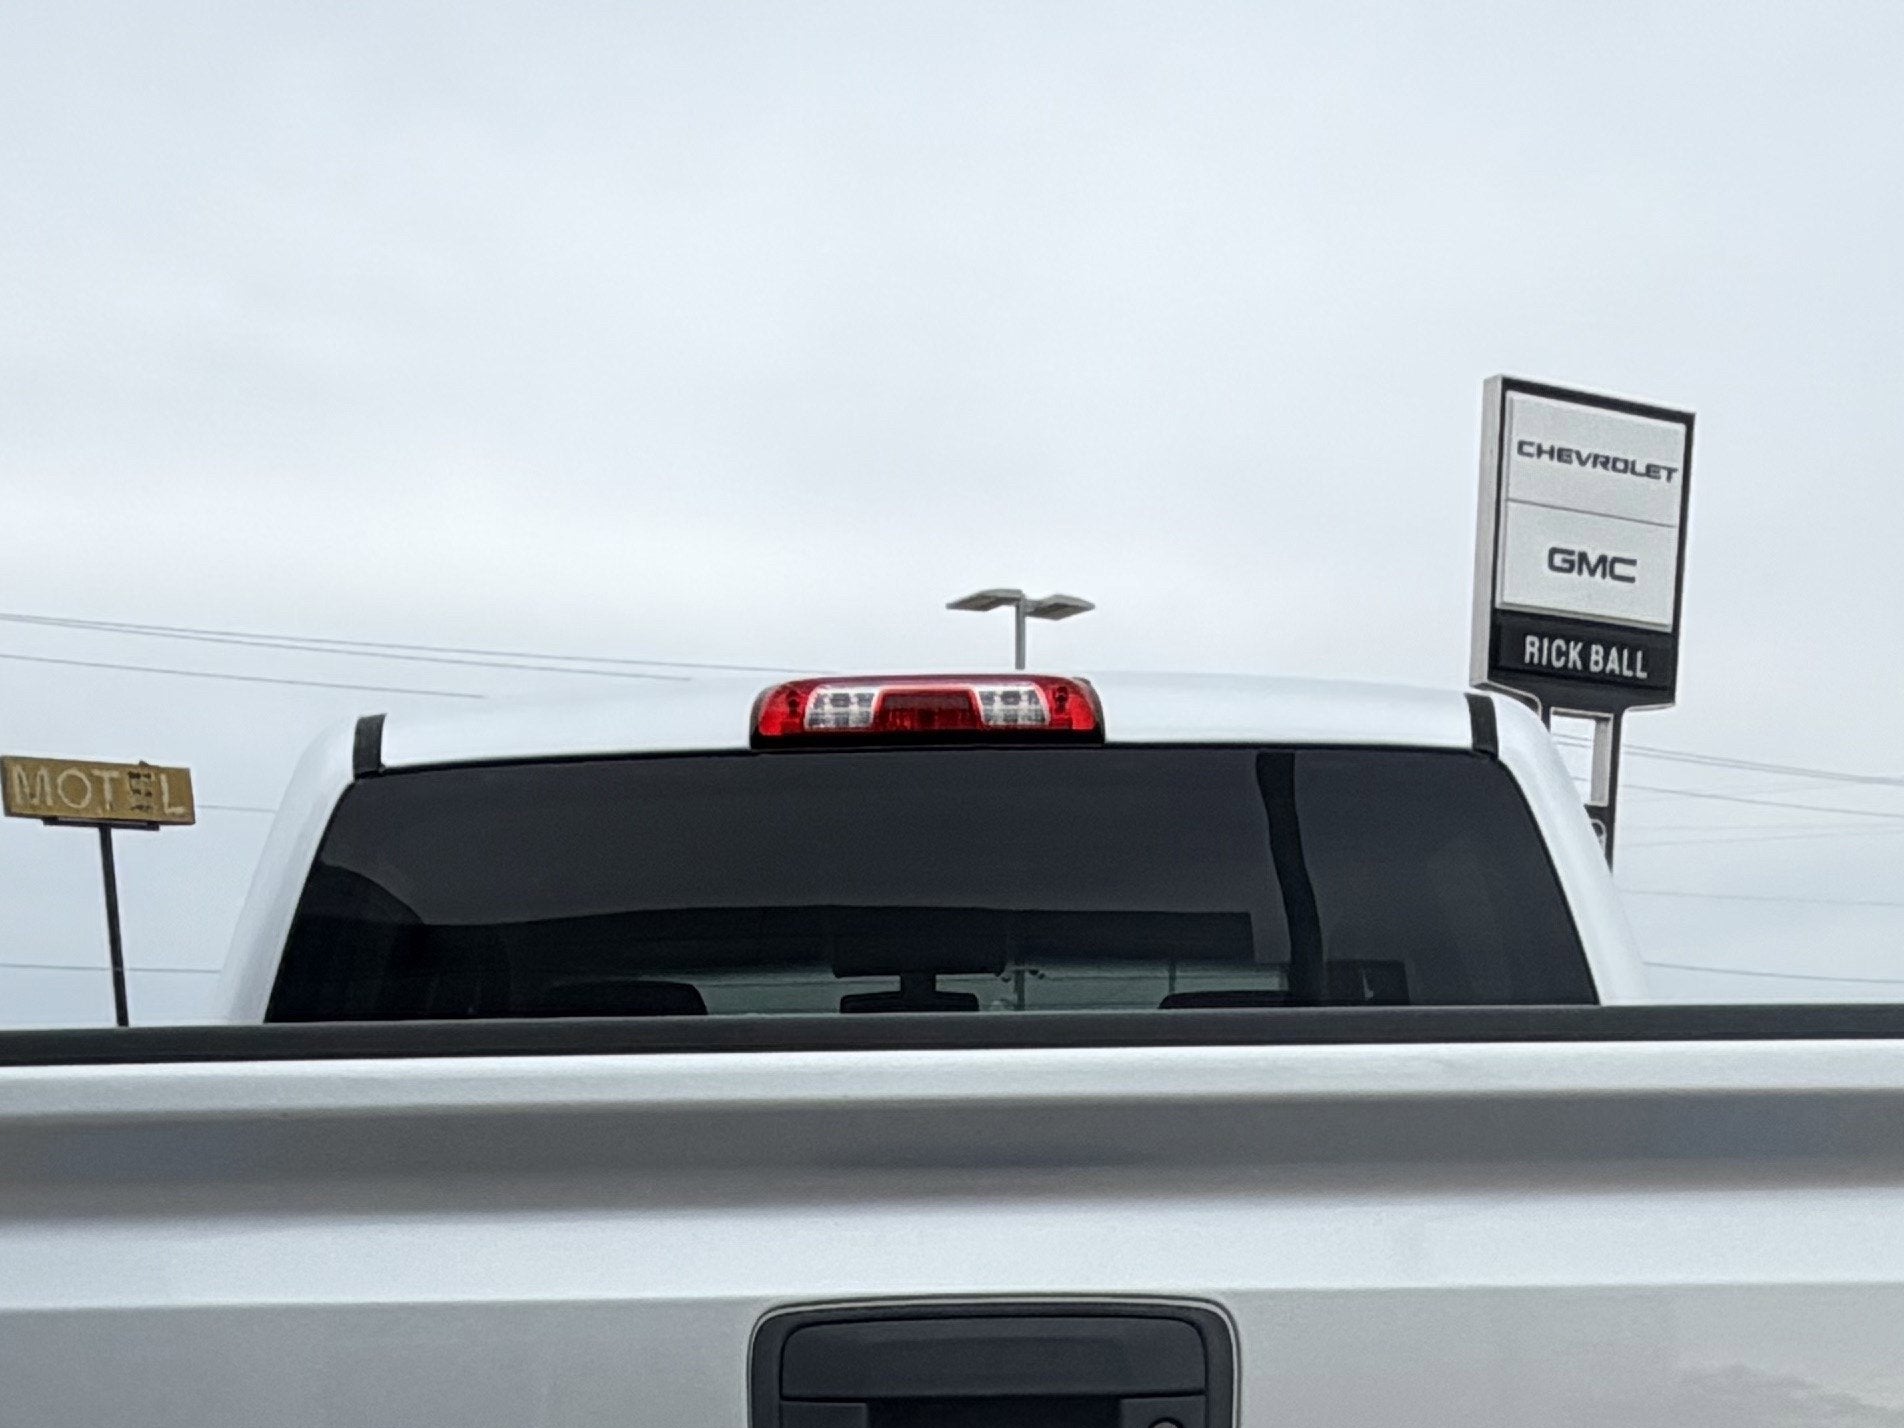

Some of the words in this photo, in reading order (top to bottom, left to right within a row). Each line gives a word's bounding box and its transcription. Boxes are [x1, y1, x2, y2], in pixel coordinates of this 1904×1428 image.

[1516, 439, 1679, 484] CHEVROLET
[1547, 546, 1638, 584] GMC
[1524, 634, 1584, 672] RICK
[1589, 644, 1648, 679] BALL
[11, 764, 186, 815] MOTEL
